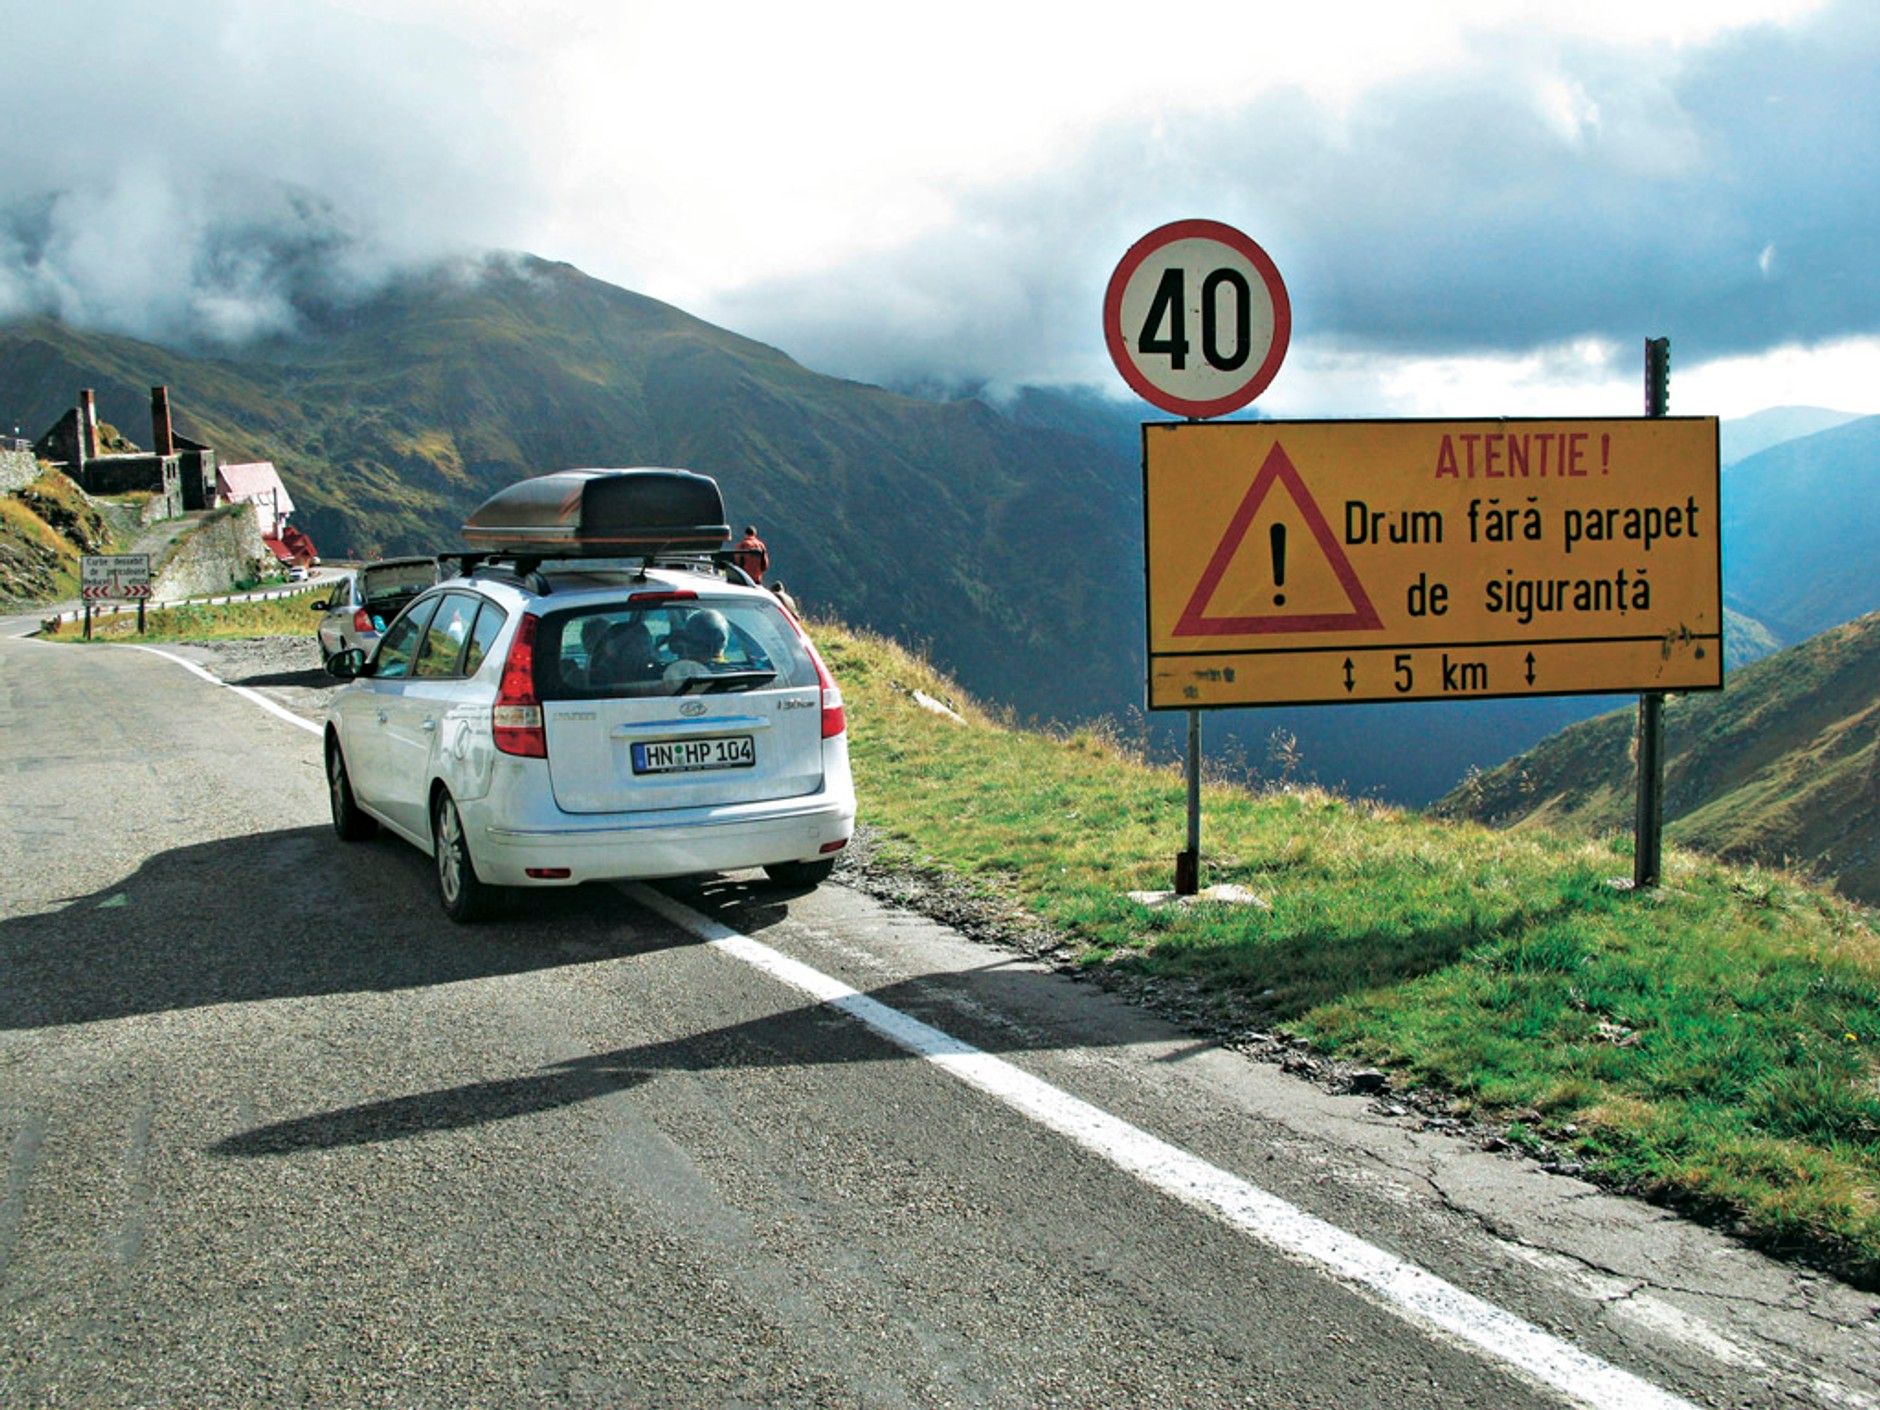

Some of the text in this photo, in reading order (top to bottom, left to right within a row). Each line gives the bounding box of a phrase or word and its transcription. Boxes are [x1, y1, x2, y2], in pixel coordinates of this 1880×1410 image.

[1138, 267, 1251, 372] 40
[1434, 433, 1589, 479] ATENTIE
[1345, 496, 1700, 554] Drum fără parapet
[1407, 572, 1449, 616] de
[1394, 653, 1488, 693] 5 km
[646, 745, 674, 768] HN
[685, 743, 711, 763] HP
[716, 740, 752, 762] 104
